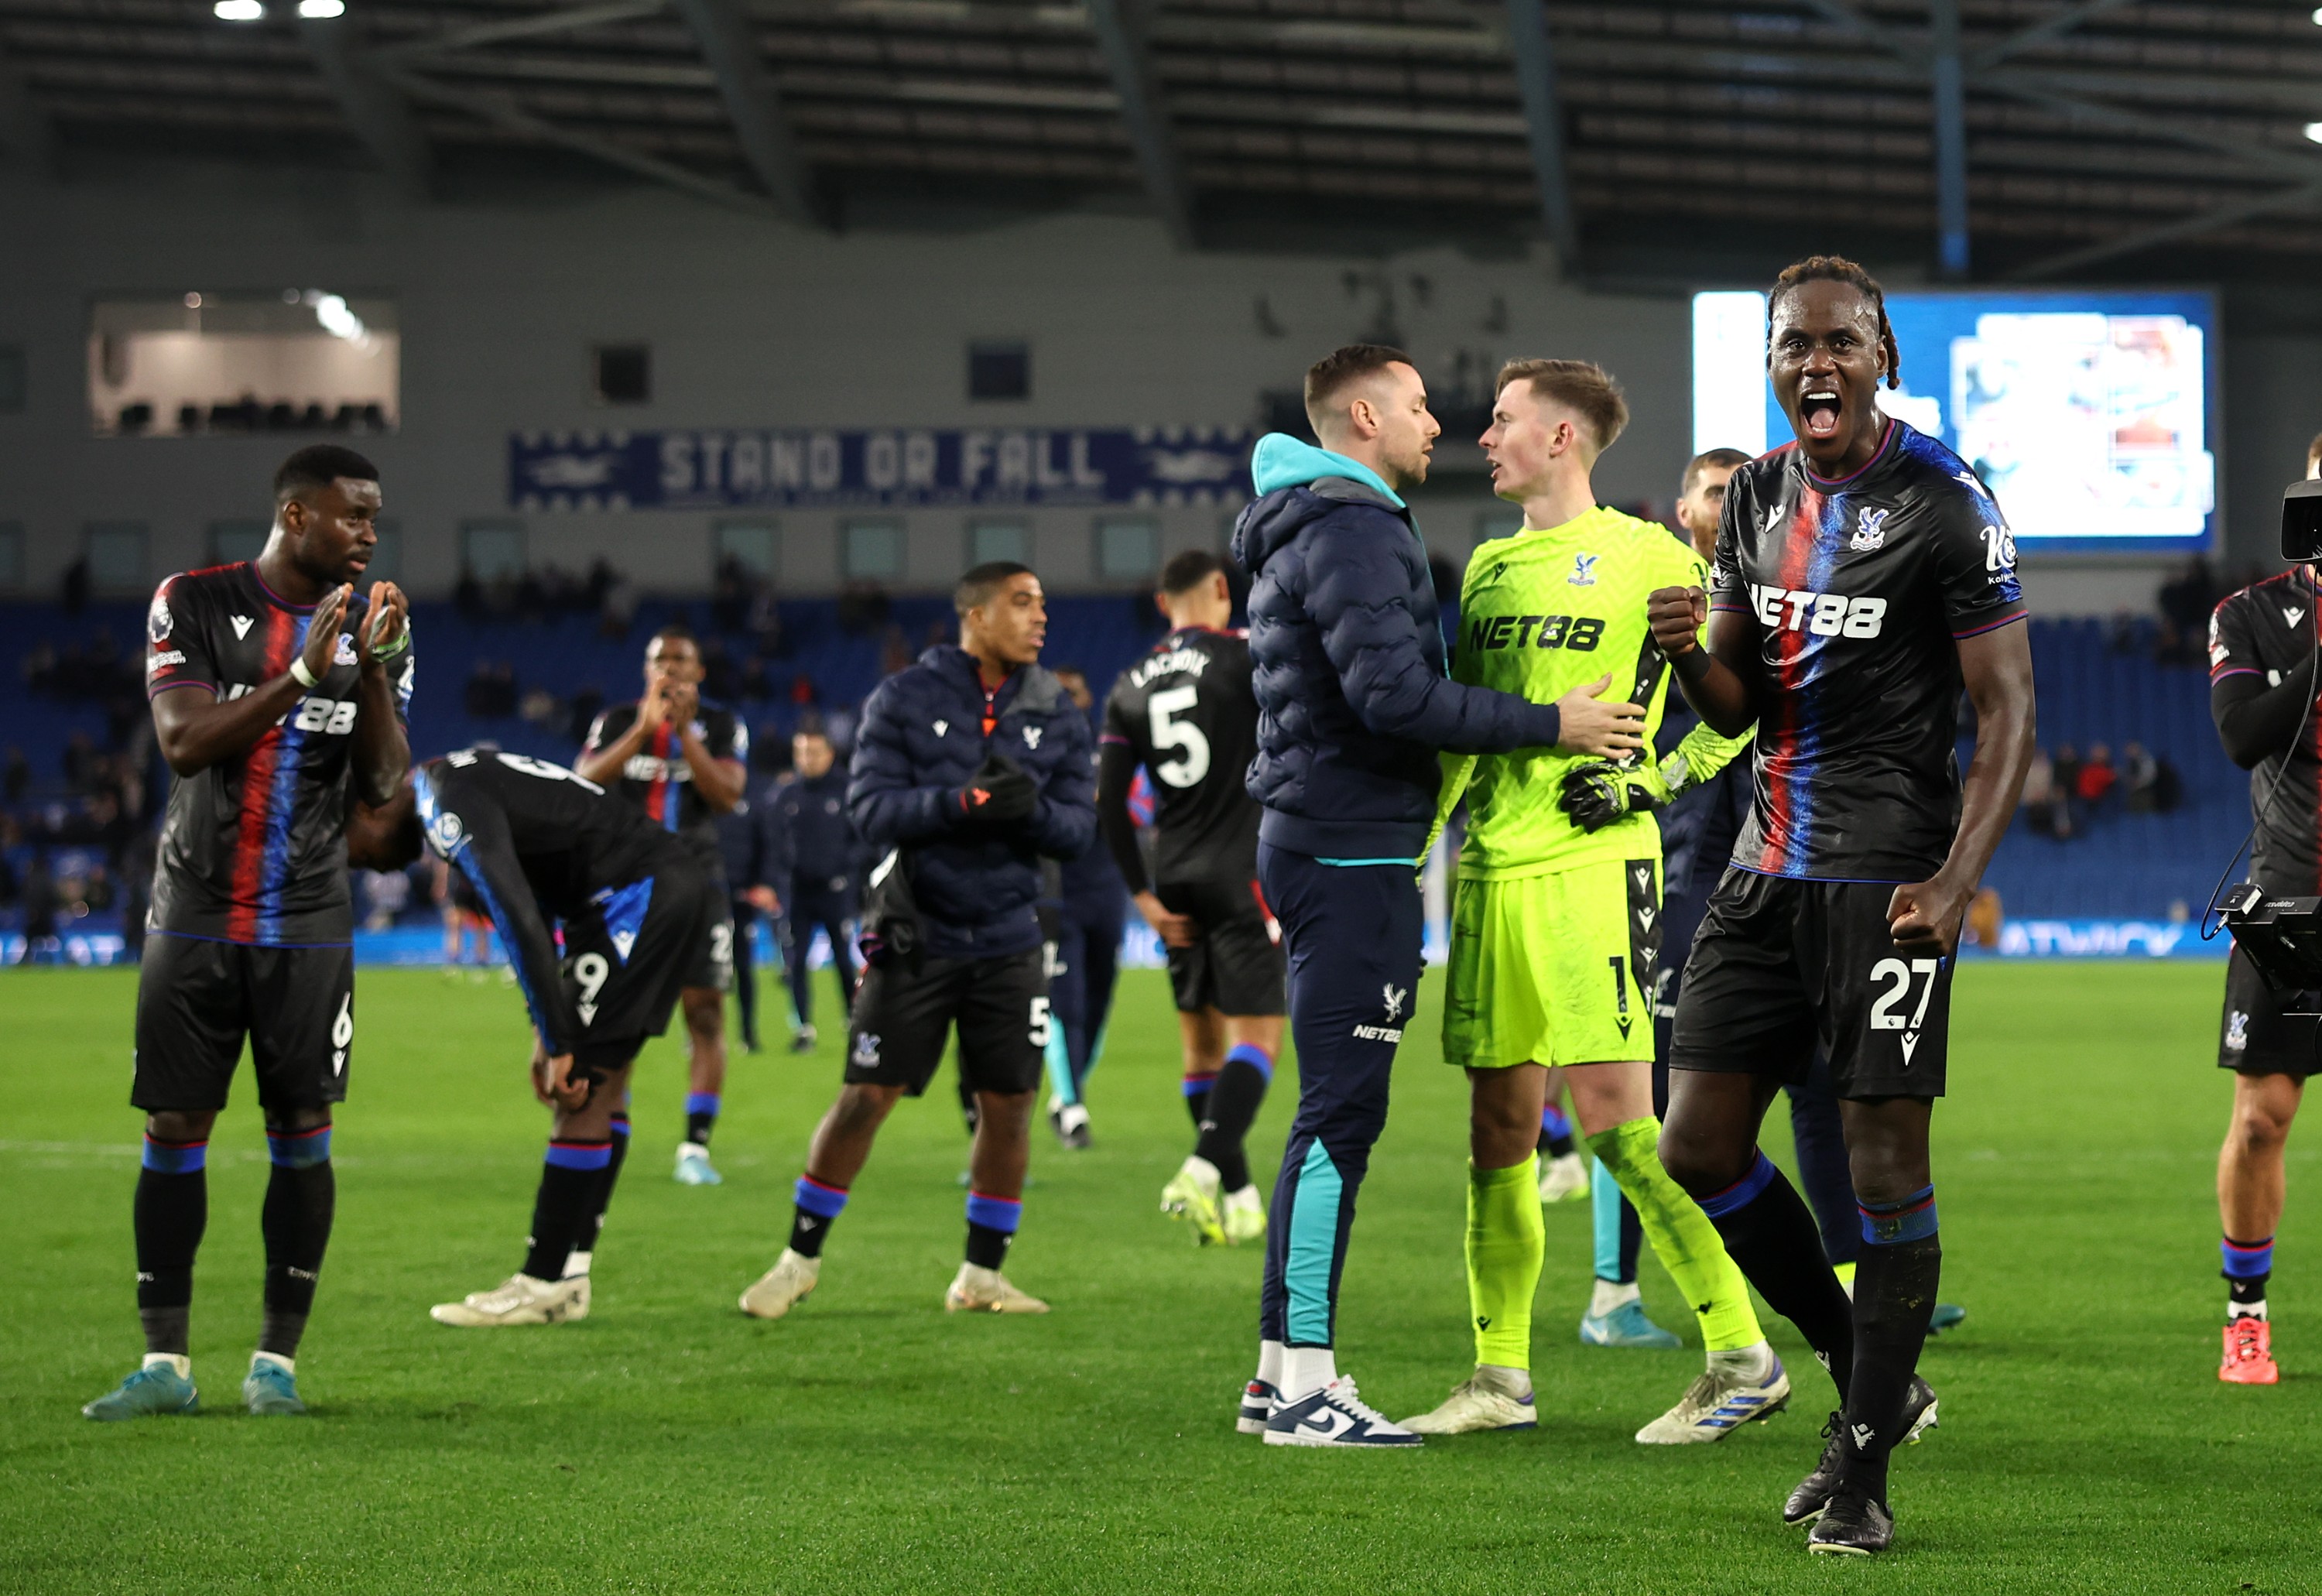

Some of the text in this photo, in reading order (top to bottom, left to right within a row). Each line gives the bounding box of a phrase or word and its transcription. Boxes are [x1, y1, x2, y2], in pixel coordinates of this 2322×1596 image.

[660, 433, 1105, 491] STAND OR FALL
[1471, 615, 1605, 652] NET88
[1149, 684, 1211, 789] 5
[574, 952, 609, 1002] 9
[1608, 956, 1628, 1013] 1
[1870, 957, 1937, 1029] 27
[331, 991, 354, 1050] 6
[1028, 995, 1051, 1046] 5
